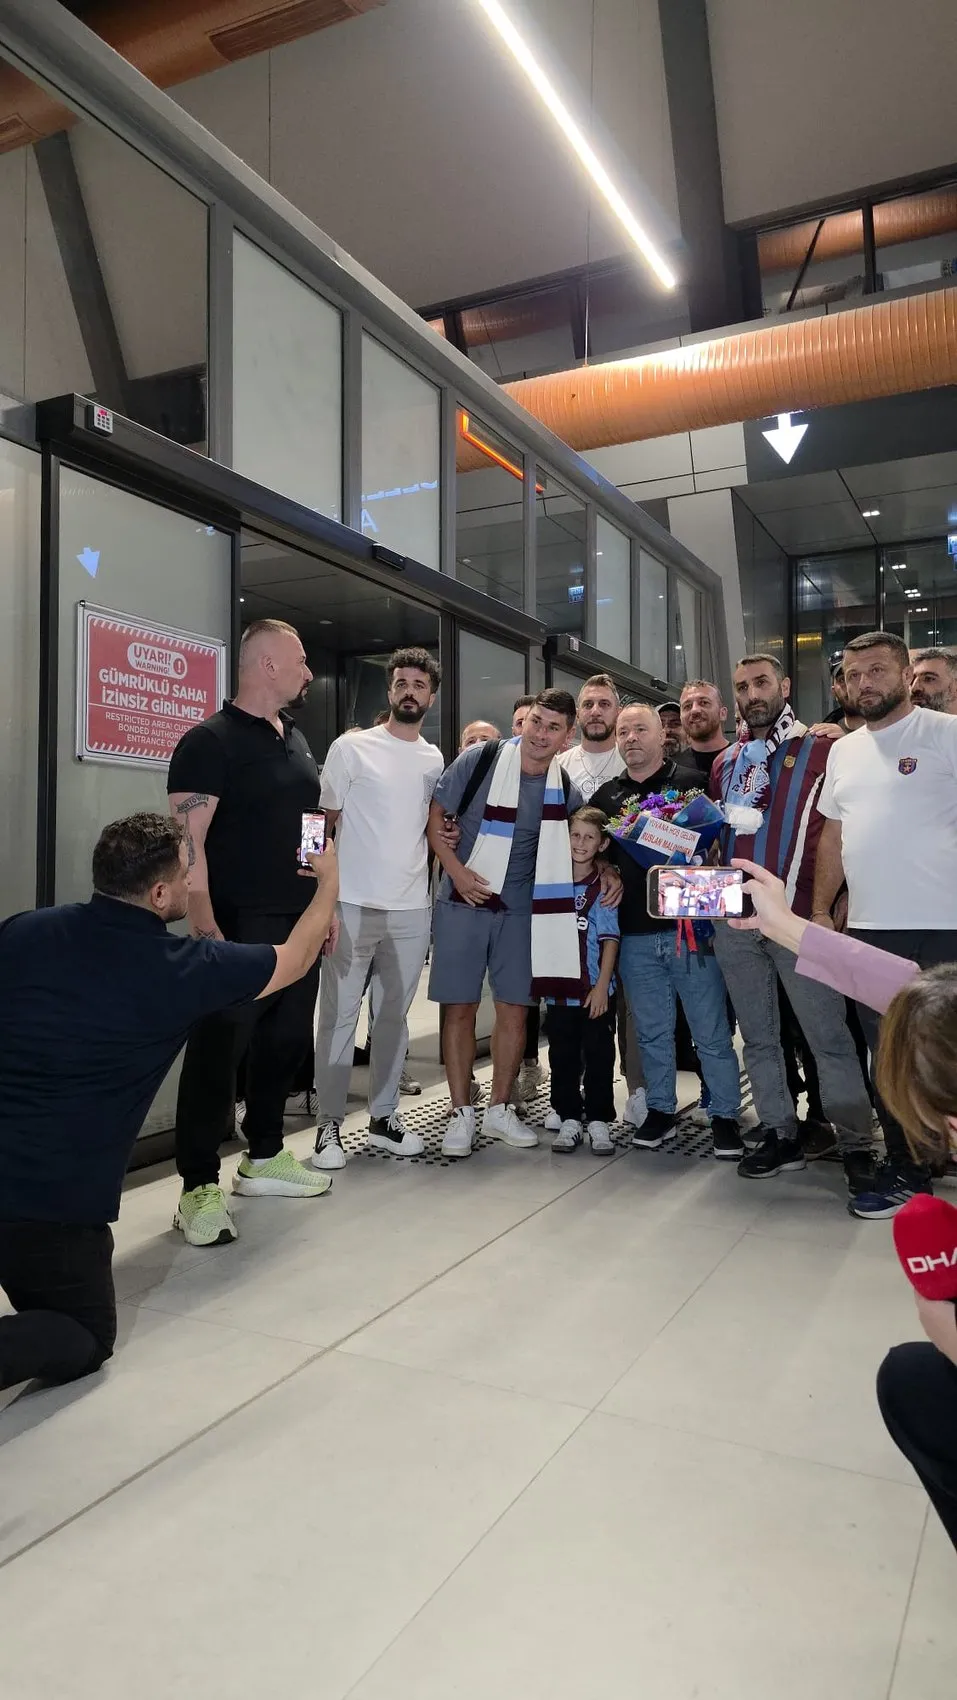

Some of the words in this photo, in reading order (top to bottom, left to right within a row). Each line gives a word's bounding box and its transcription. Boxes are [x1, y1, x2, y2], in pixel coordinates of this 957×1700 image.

[133, 645, 171, 665] UYARI!
[135, 660, 170, 674] WARNING!
[98, 667, 170, 696] GÜMRÜKLÜ
[172, 684, 207, 703] SAHA!
[102, 686, 149, 711] İZİNSİZ
[151, 697, 205, 721] GİRİLMEZ
[105, 711, 150, 726] RESTRICTED
[151, 720, 173, 730] AREA!
[173, 723, 192, 733] CUST
[118, 723, 150, 735] BONDED
[151, 729, 184, 740] AUTHORI
[127, 733, 166, 747] ENTRANCE
[166, 740, 179, 748] ON
